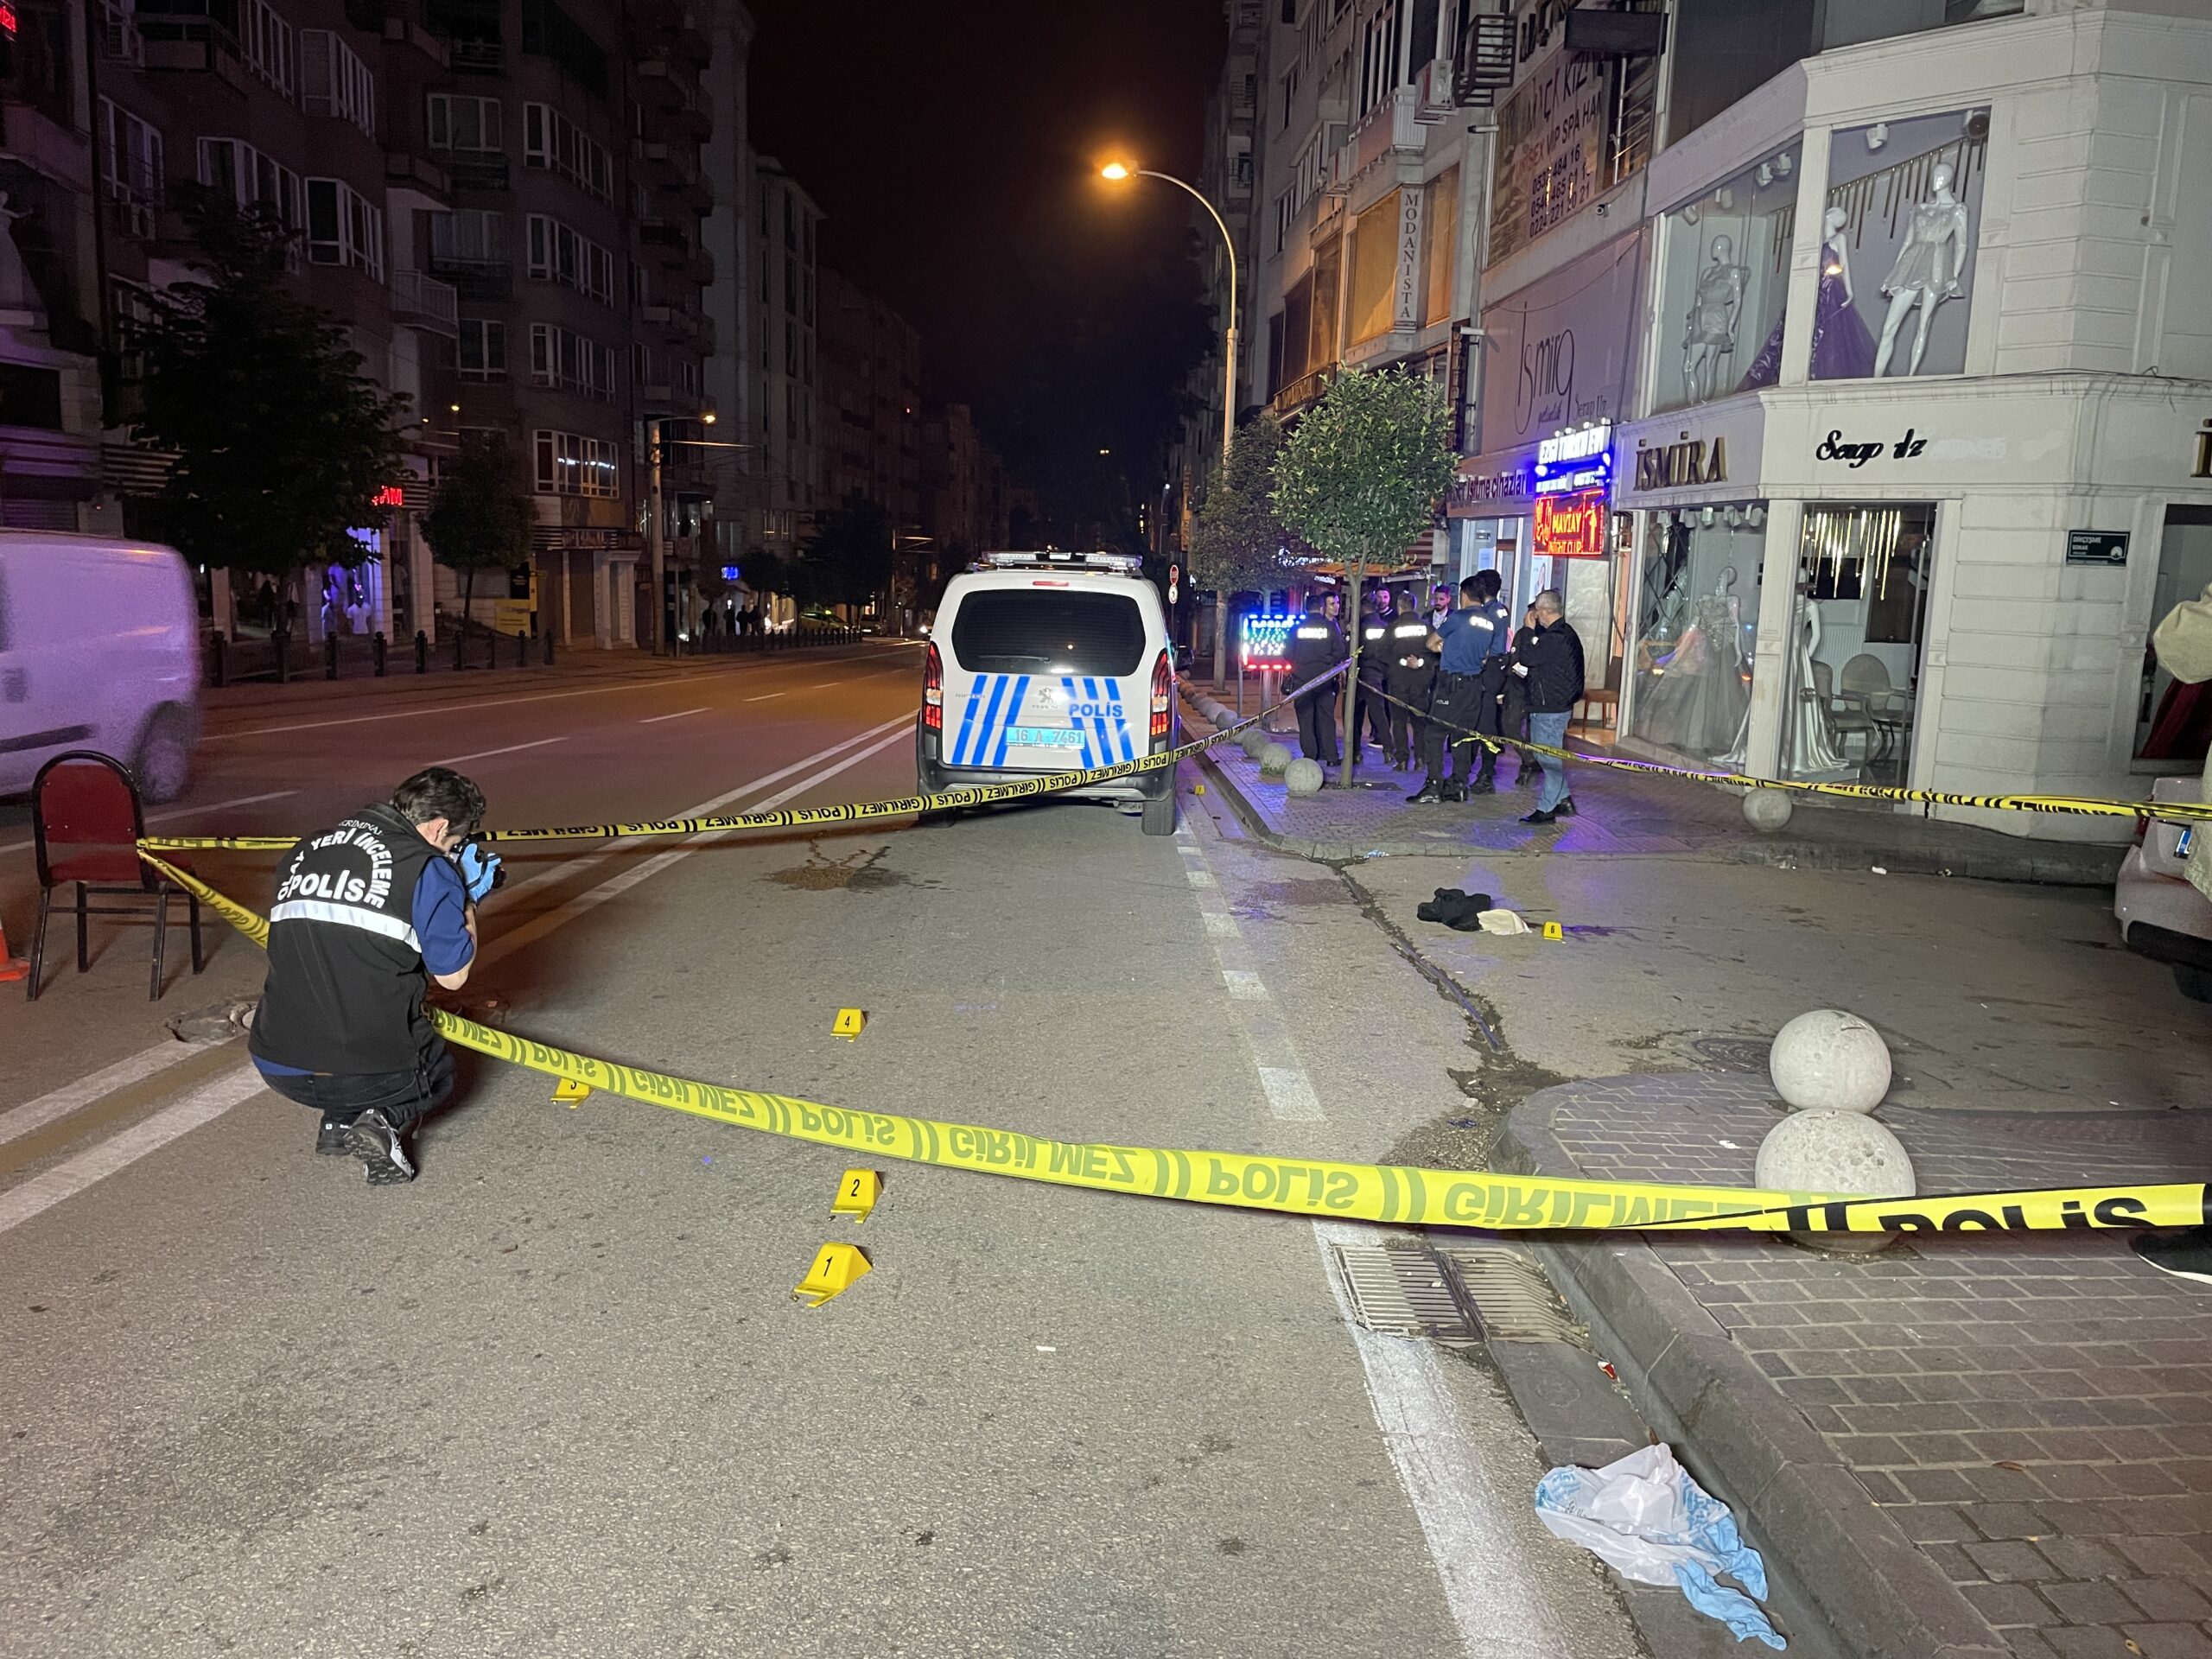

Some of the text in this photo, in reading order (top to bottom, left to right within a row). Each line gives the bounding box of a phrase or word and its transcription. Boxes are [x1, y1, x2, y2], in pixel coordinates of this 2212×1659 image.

[1562, 108, 1580, 144] SPA
[1571, 143, 1580, 164] 16
[1550, 200, 1564, 225] 221
[1580, 181, 1590, 205] 21
[1400, 194, 1420, 319] MODANISTA
[1632, 430, 1729, 492] İSMİRA
[1069, 702, 1124, 717] POLİS
[844, 1015, 851, 1028] 4
[850, 1179, 861, 1198] 2
[823, 1255, 833, 1277] 1
